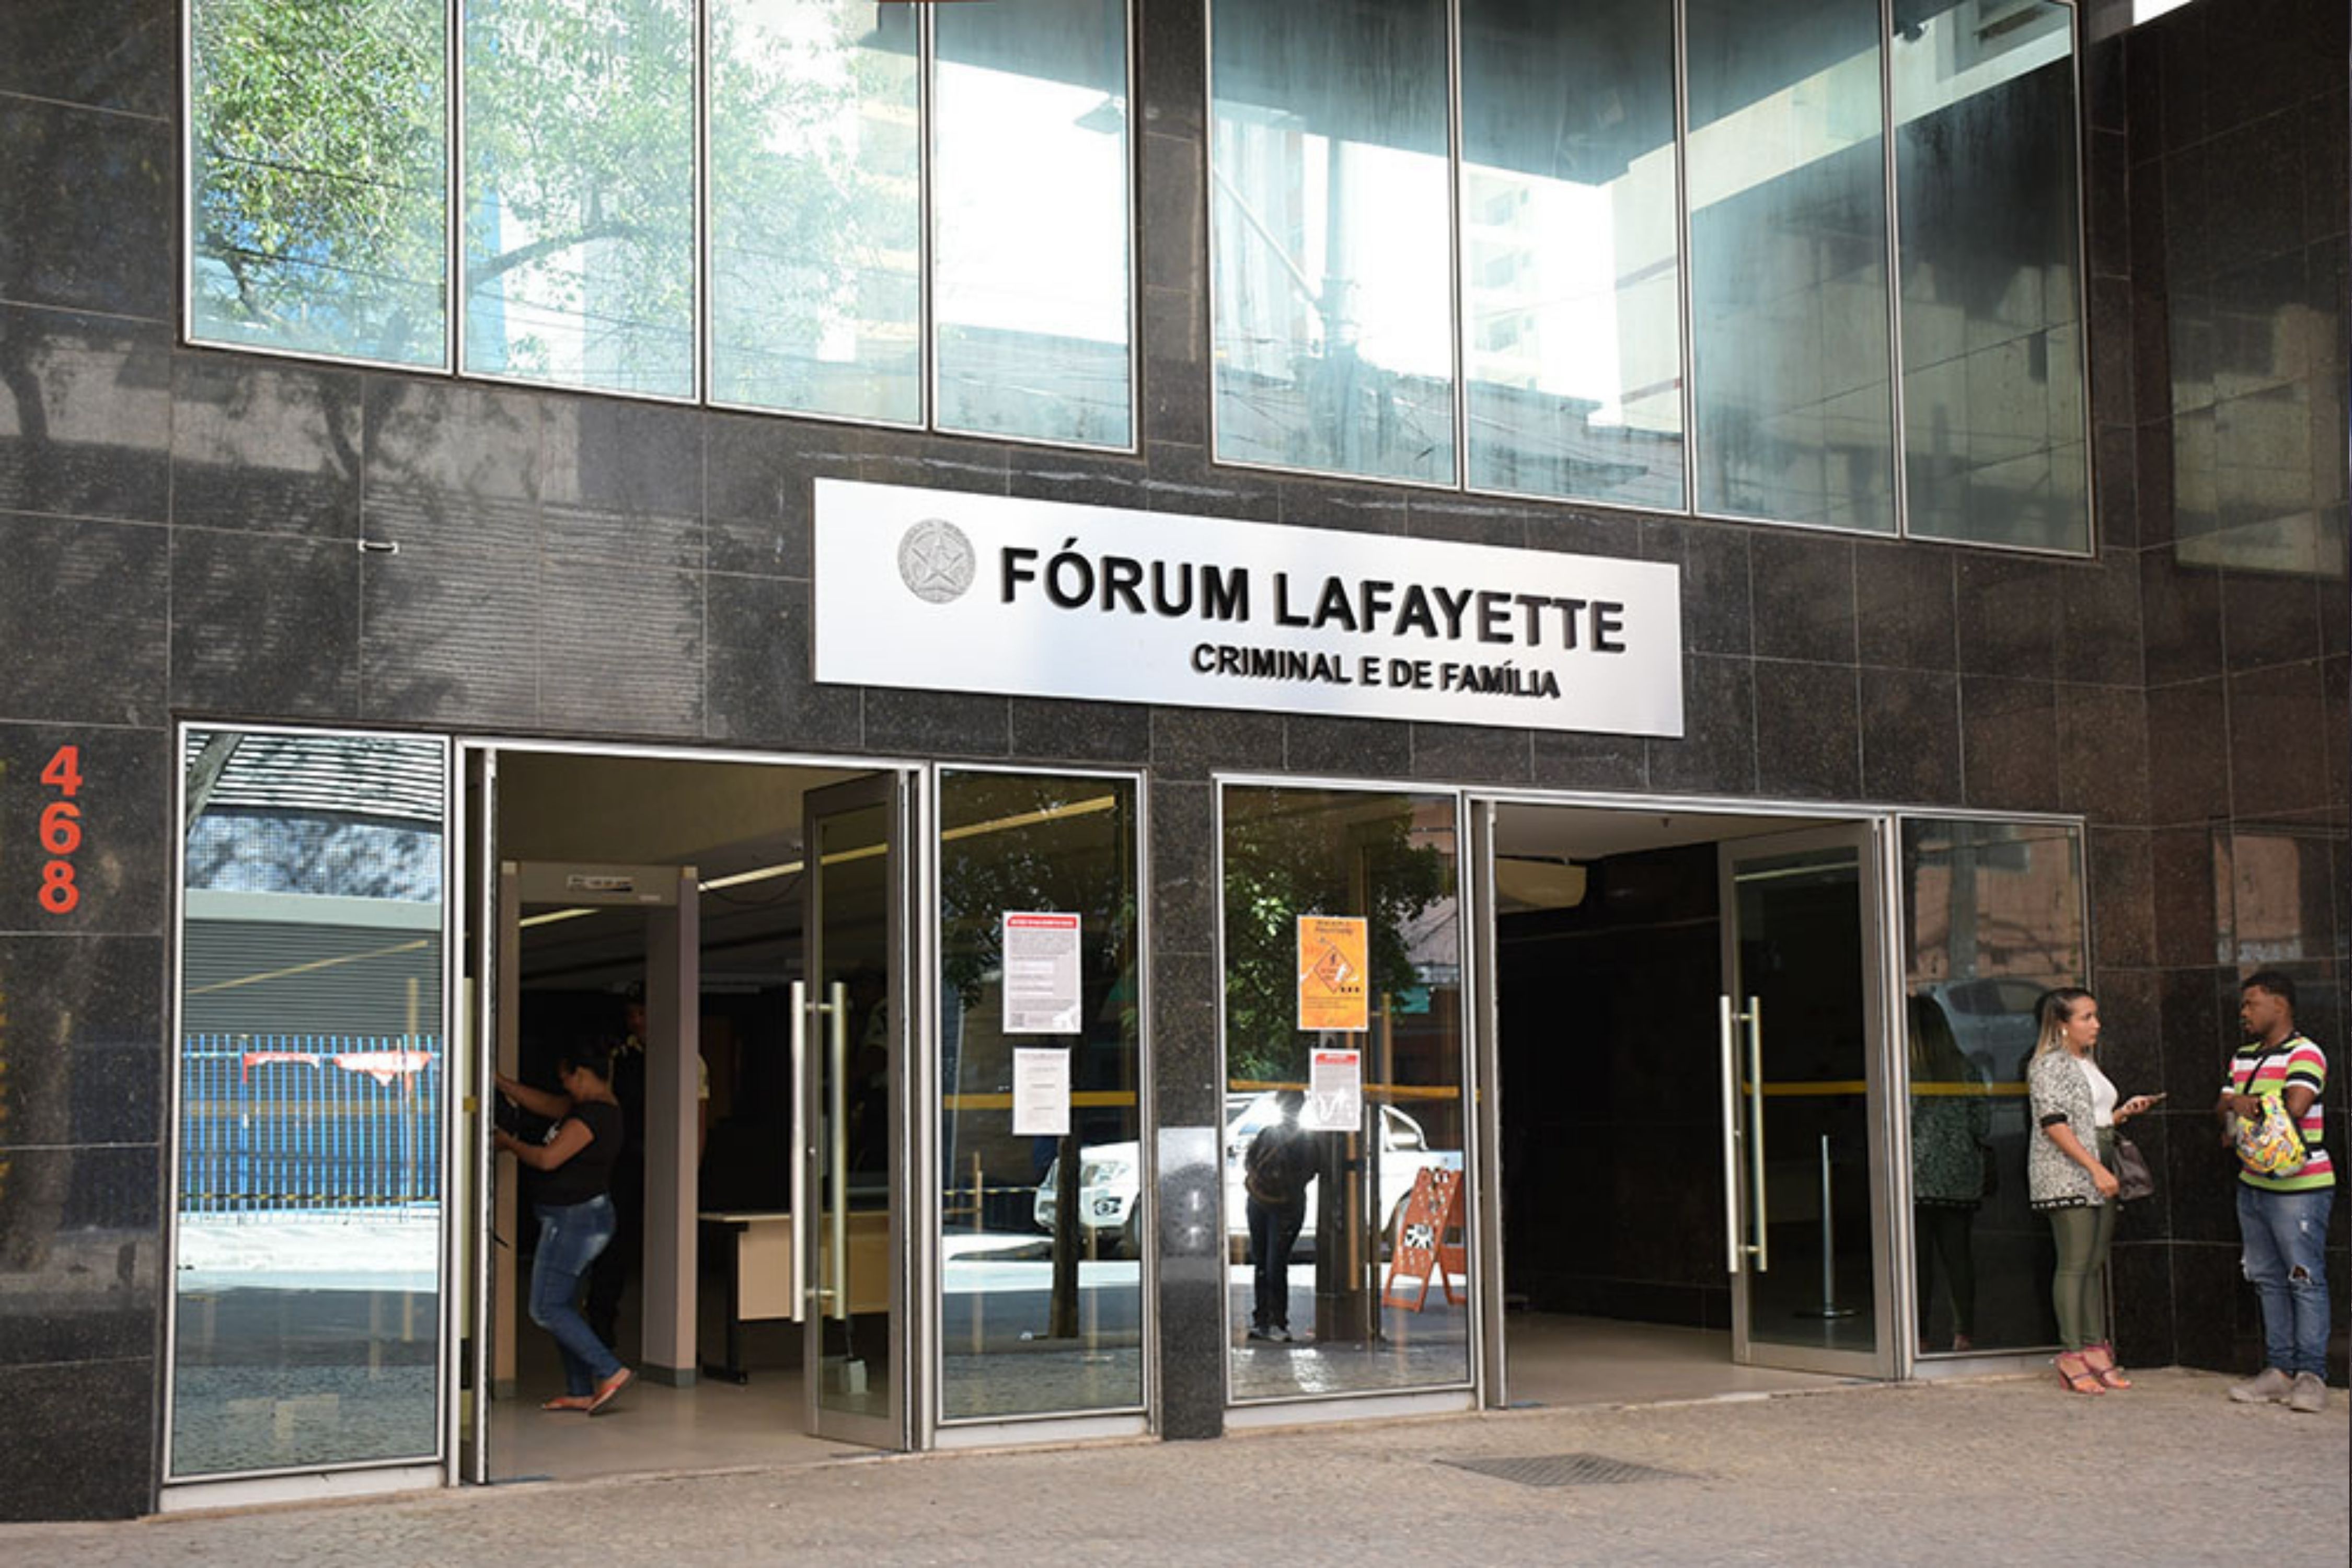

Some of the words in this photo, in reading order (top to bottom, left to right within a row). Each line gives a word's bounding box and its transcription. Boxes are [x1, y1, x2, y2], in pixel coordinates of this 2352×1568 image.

[1002, 537, 1250, 622] FÓRUM
[1274, 572, 1625, 653] LAFAYETTE
[1192, 643, 1352, 684] CRIMINAL
[1361, 656, 1382, 686] E
[1389, 659, 1434, 689] DE
[1440, 661, 1561, 699] FAMÍLIA
[38, 745, 83, 914] 468
